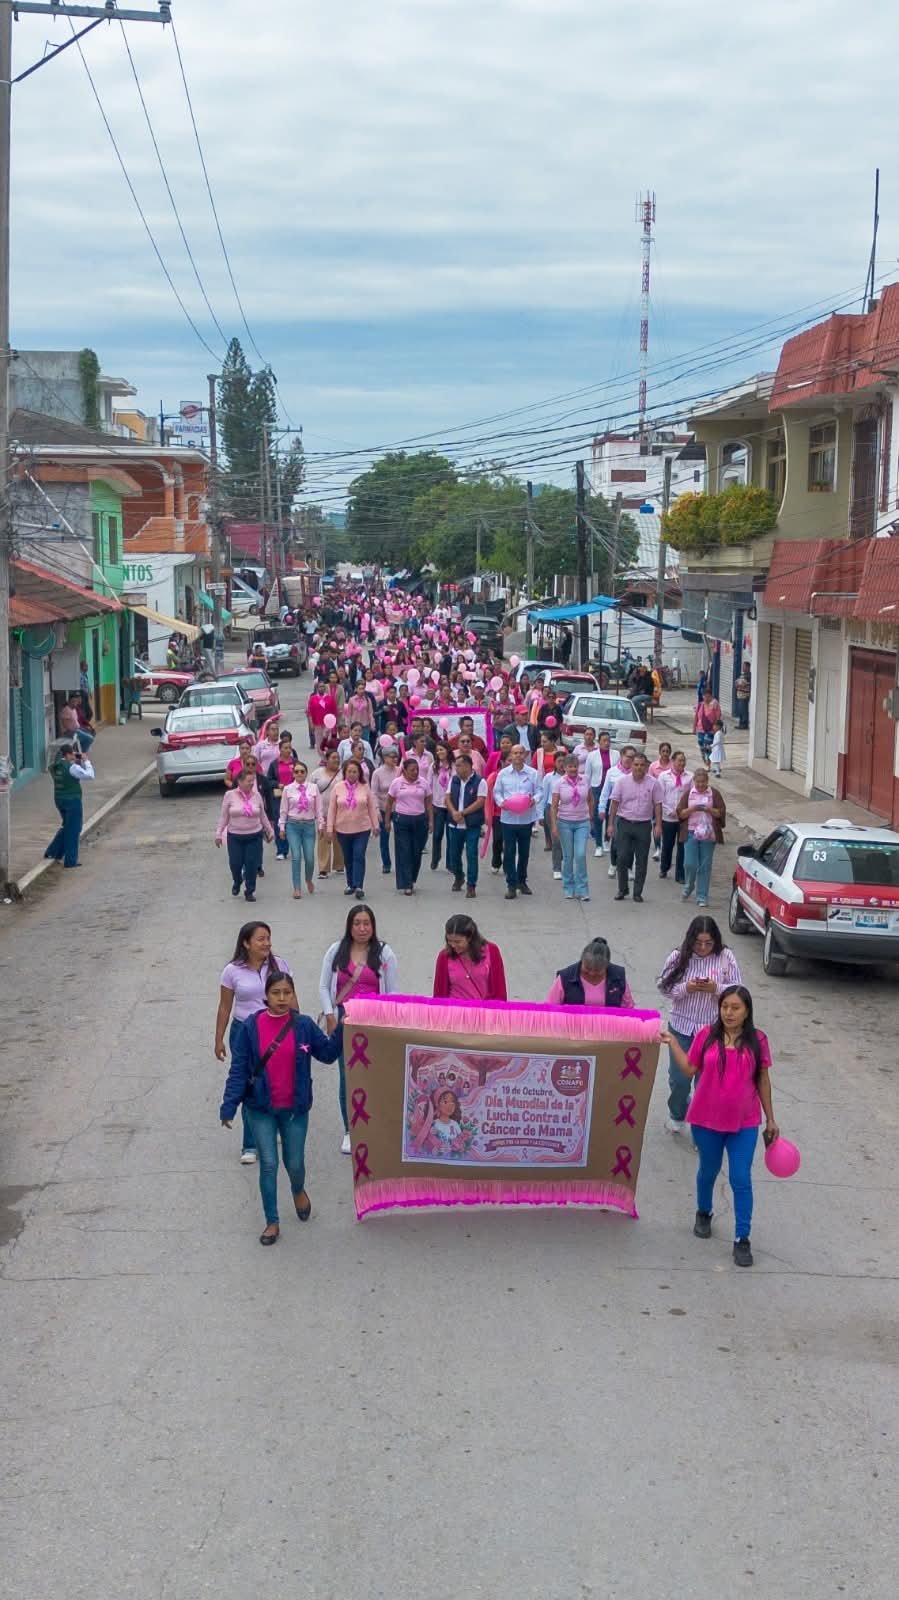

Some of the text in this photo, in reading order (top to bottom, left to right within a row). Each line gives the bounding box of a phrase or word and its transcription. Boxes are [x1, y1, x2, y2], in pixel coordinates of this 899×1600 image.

[812, 851, 827, 862] 63
[502, 1086, 511, 1095] 19
[512, 1087, 521, 1095] de
[485, 1095, 574, 1111] Día Mundial de la
[487, 1109, 571, 1124] Lucha Contra el
[481, 1121, 573, 1137] Cáncer de Mama
